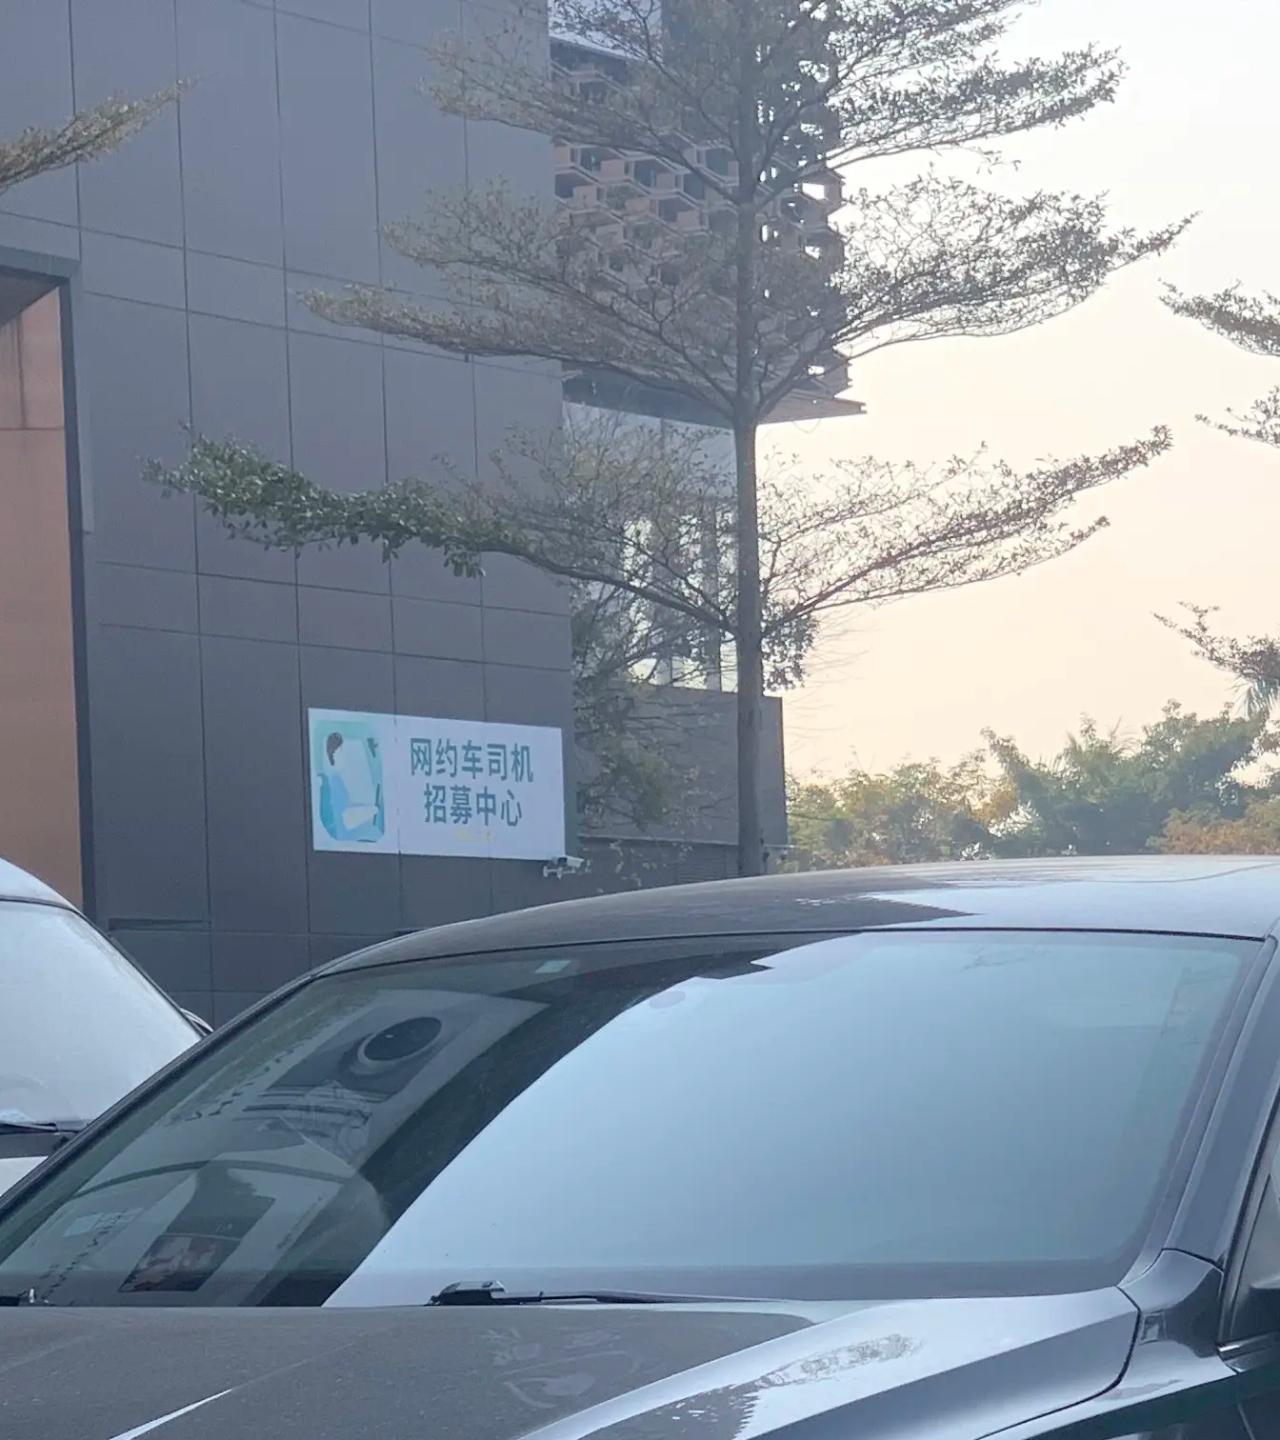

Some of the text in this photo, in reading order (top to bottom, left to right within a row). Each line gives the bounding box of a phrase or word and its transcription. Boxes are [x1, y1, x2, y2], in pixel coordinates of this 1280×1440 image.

[410, 737, 534, 783] 网约车司机
[423, 783, 522, 828] 招募中心
